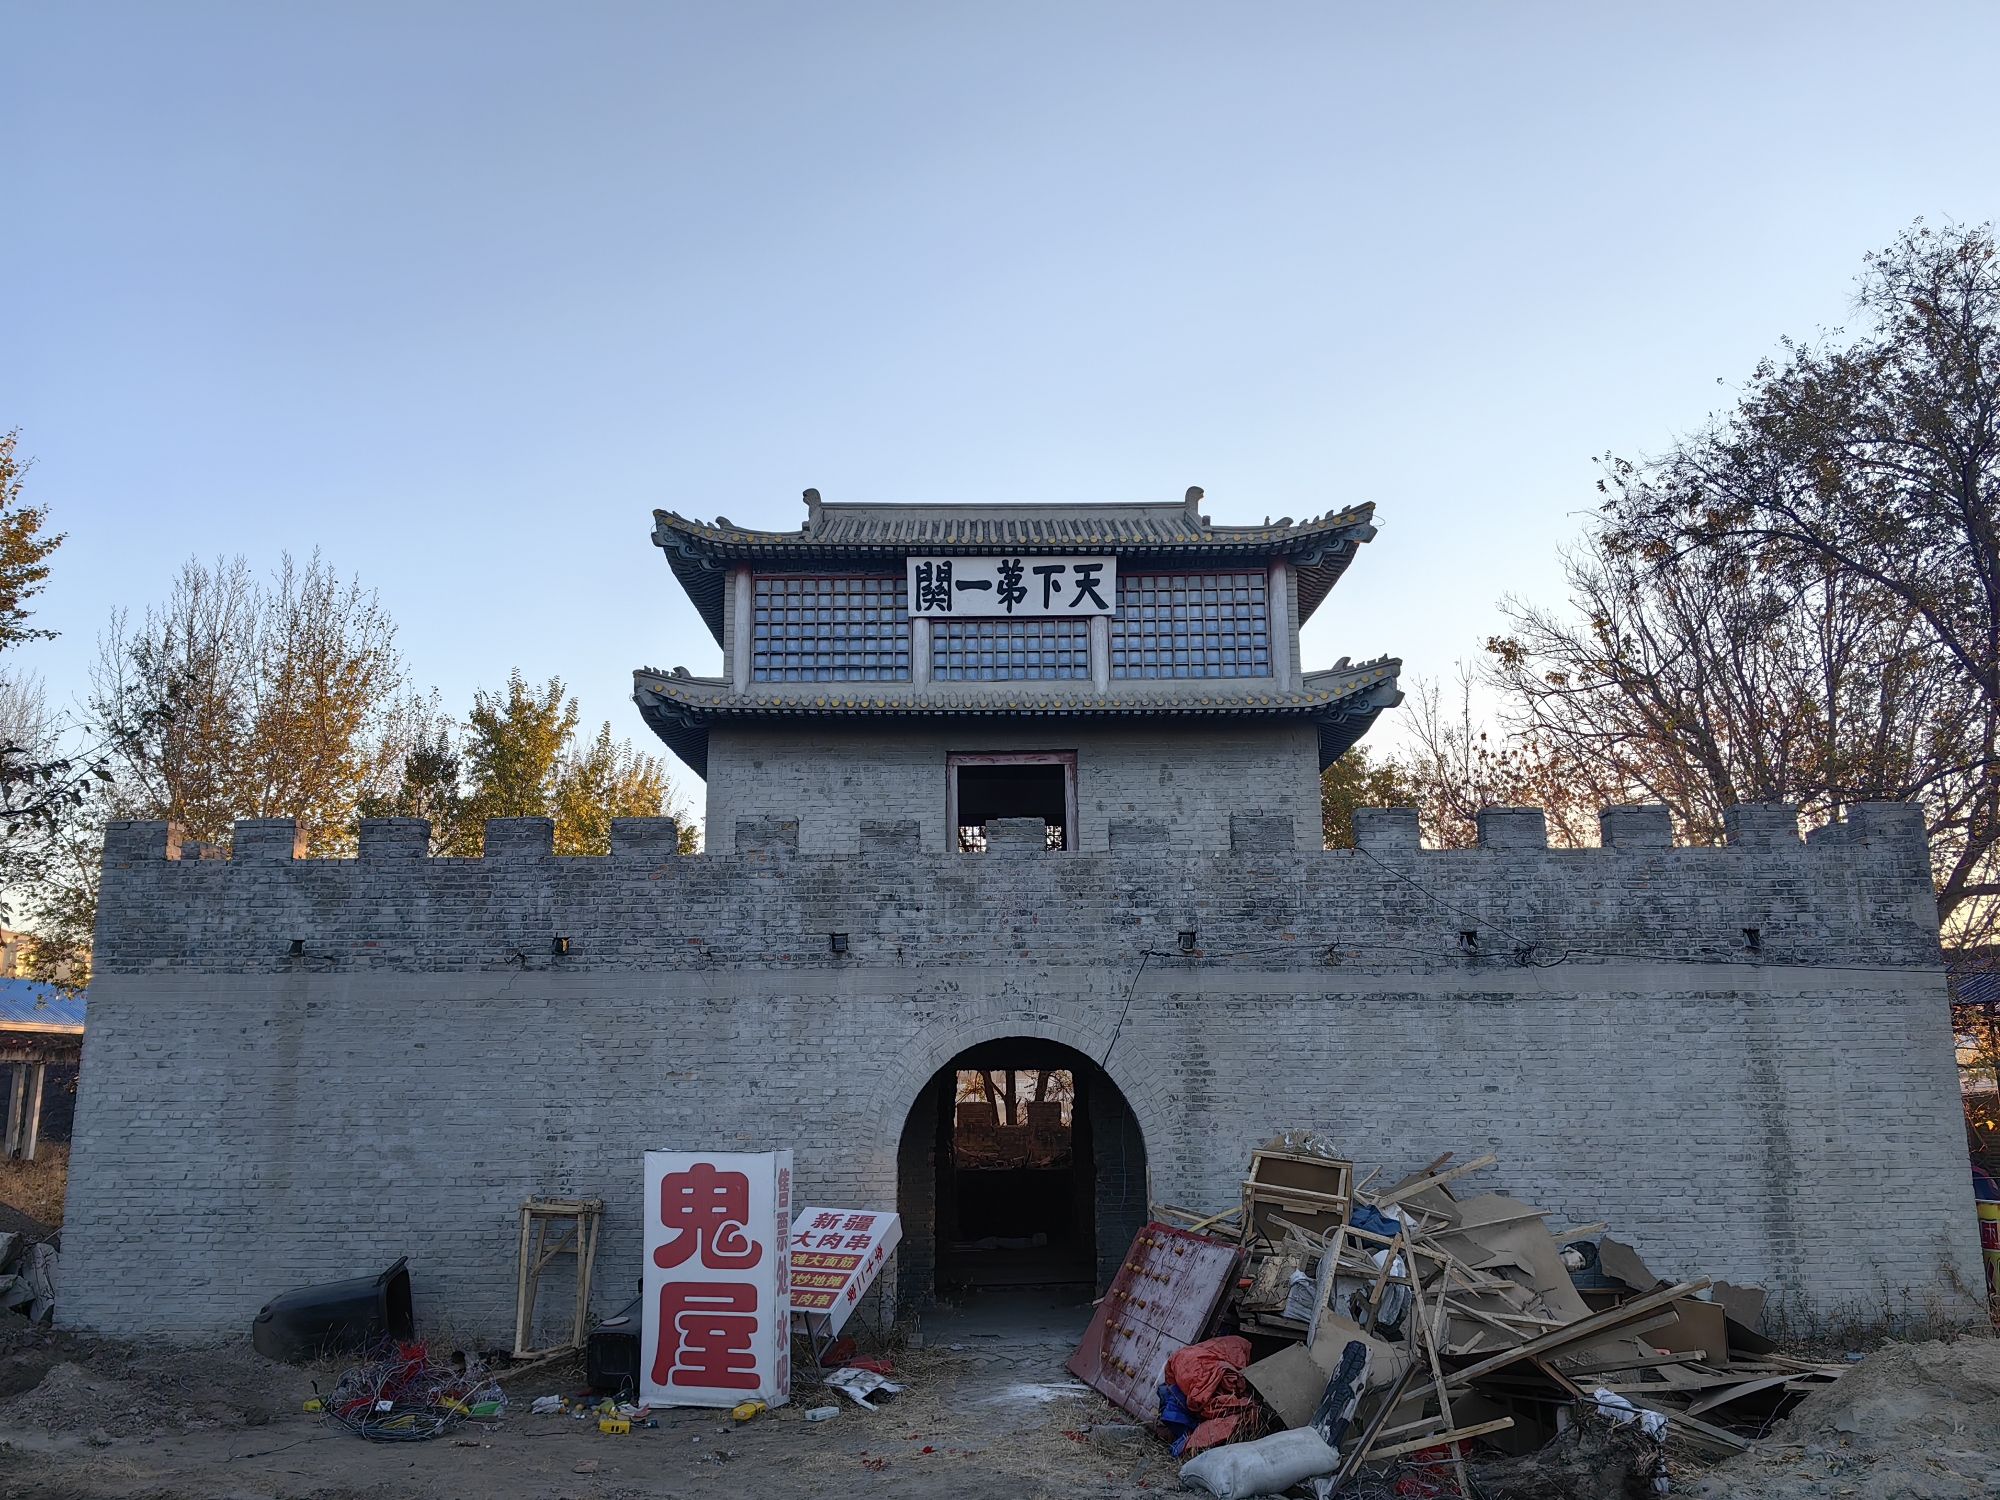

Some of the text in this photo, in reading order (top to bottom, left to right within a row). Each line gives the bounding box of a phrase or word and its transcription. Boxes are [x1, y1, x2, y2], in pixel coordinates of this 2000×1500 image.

[811, 1212, 877, 1231] 新疆
[791, 1231, 872, 1250] 大肉串
[791, 1254, 856, 1268] 魂大面筋
[651, 1163, 762, 1389] 鬼屋
[776, 1168, 790, 1396] 售票处 水吧
[791, 1272, 844, 1287] 炒地摊
